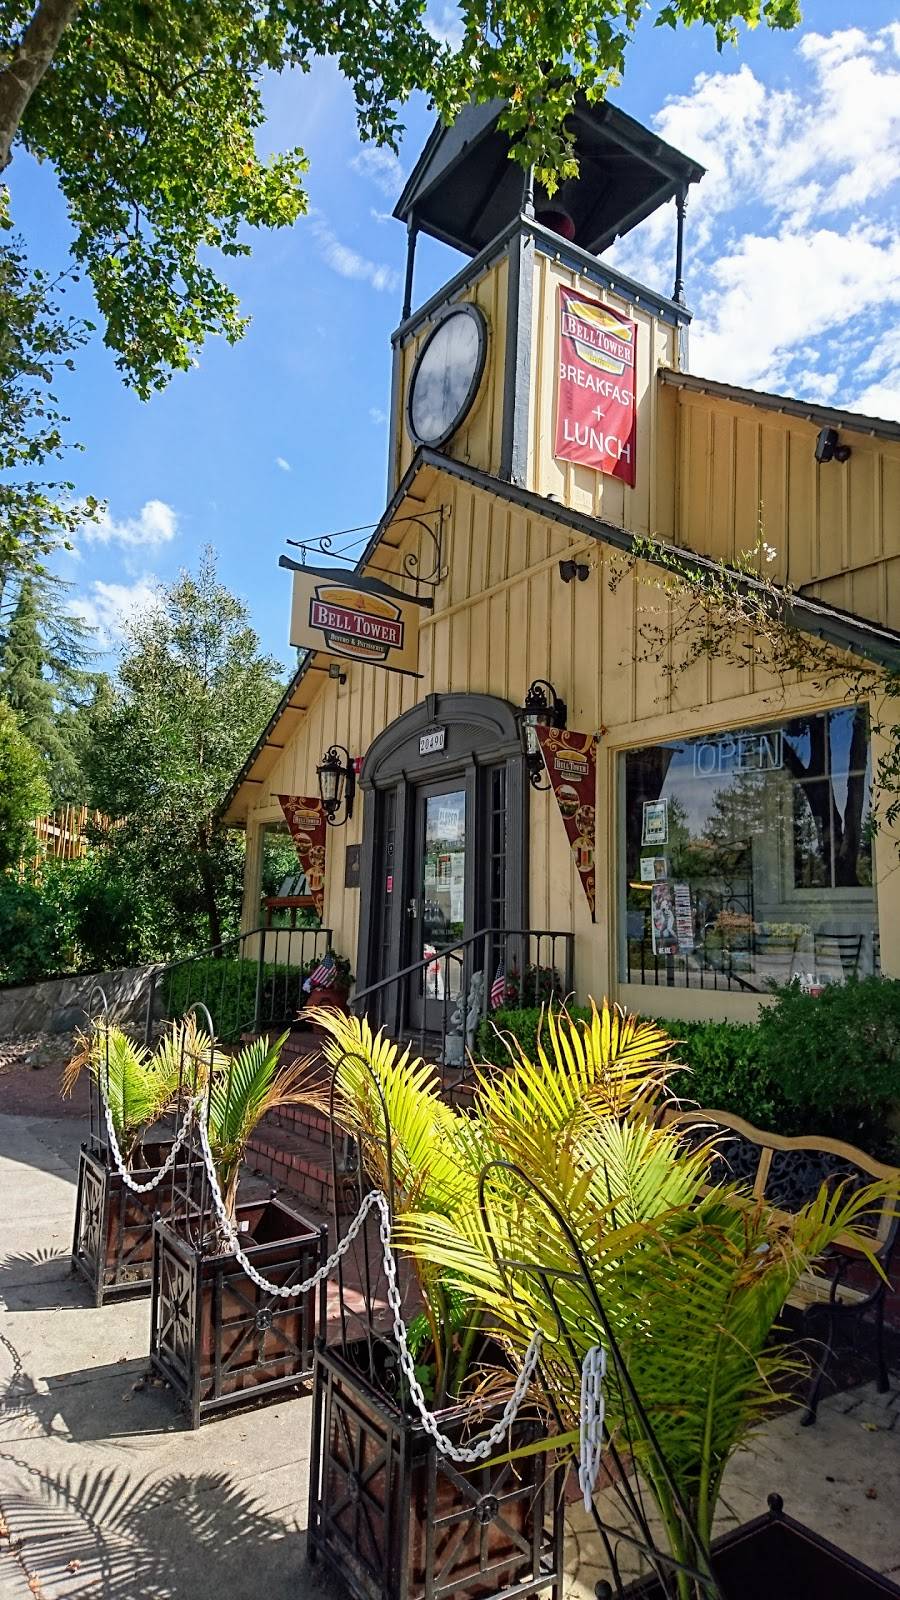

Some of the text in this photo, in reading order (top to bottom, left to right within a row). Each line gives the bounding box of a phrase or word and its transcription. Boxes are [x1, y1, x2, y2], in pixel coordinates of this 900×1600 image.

[567, 316, 596, 339] BELL
[596, 331, 631, 360] TOWER
[592, 405, 605, 421] +
[564, 418, 630, 464] LUNCH
[318, 605, 397, 642] BELL TOWER
[697, 733, 779, 774] OPEN
